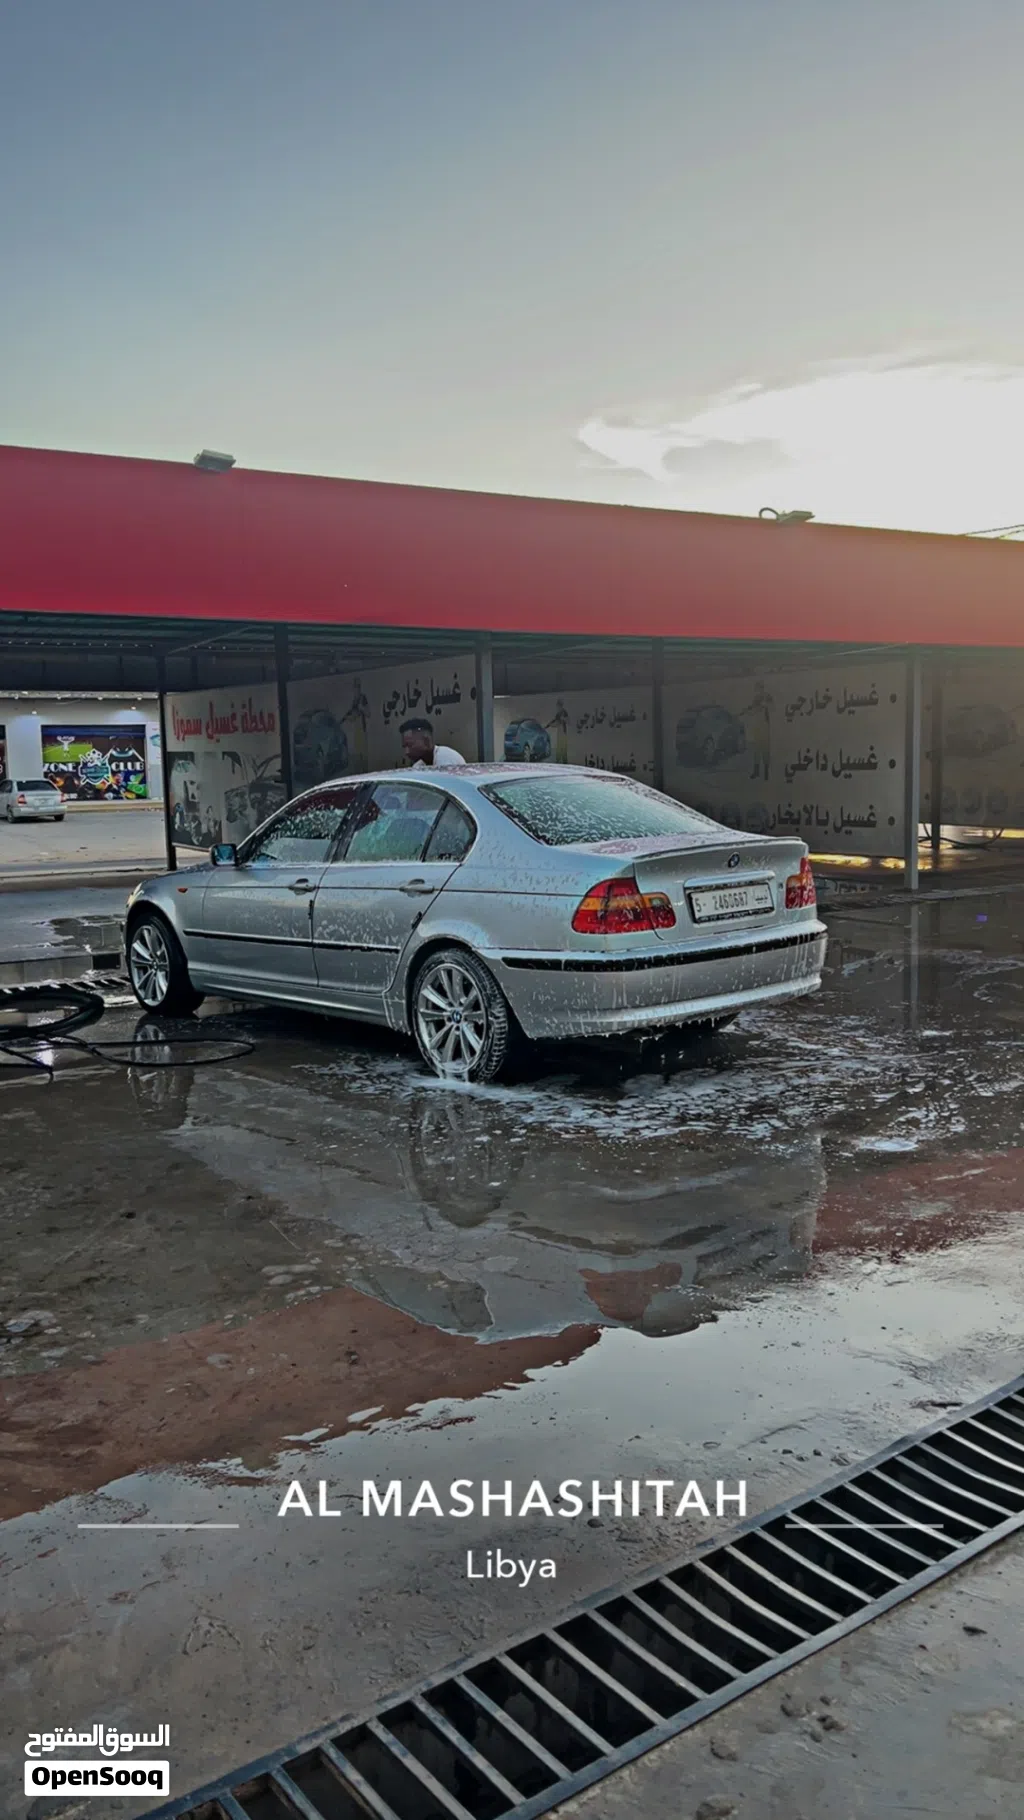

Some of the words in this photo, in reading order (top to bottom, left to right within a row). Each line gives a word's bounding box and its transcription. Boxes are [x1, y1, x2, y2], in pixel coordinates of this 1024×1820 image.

[383, 679, 422, 725] خارجي
[426, 672, 461, 715] غسيل
[785, 687, 832, 722] خارجي
[836, 683, 879, 715] غسيل
[206, 701, 239, 743] غسيل
[43, 762, 76, 772] ZONE
[111, 761, 144, 771] CLUB
[785, 748, 828, 783] داخلي
[832, 745, 878, 778] غسيل
[833, 804, 877, 834] غسيل
